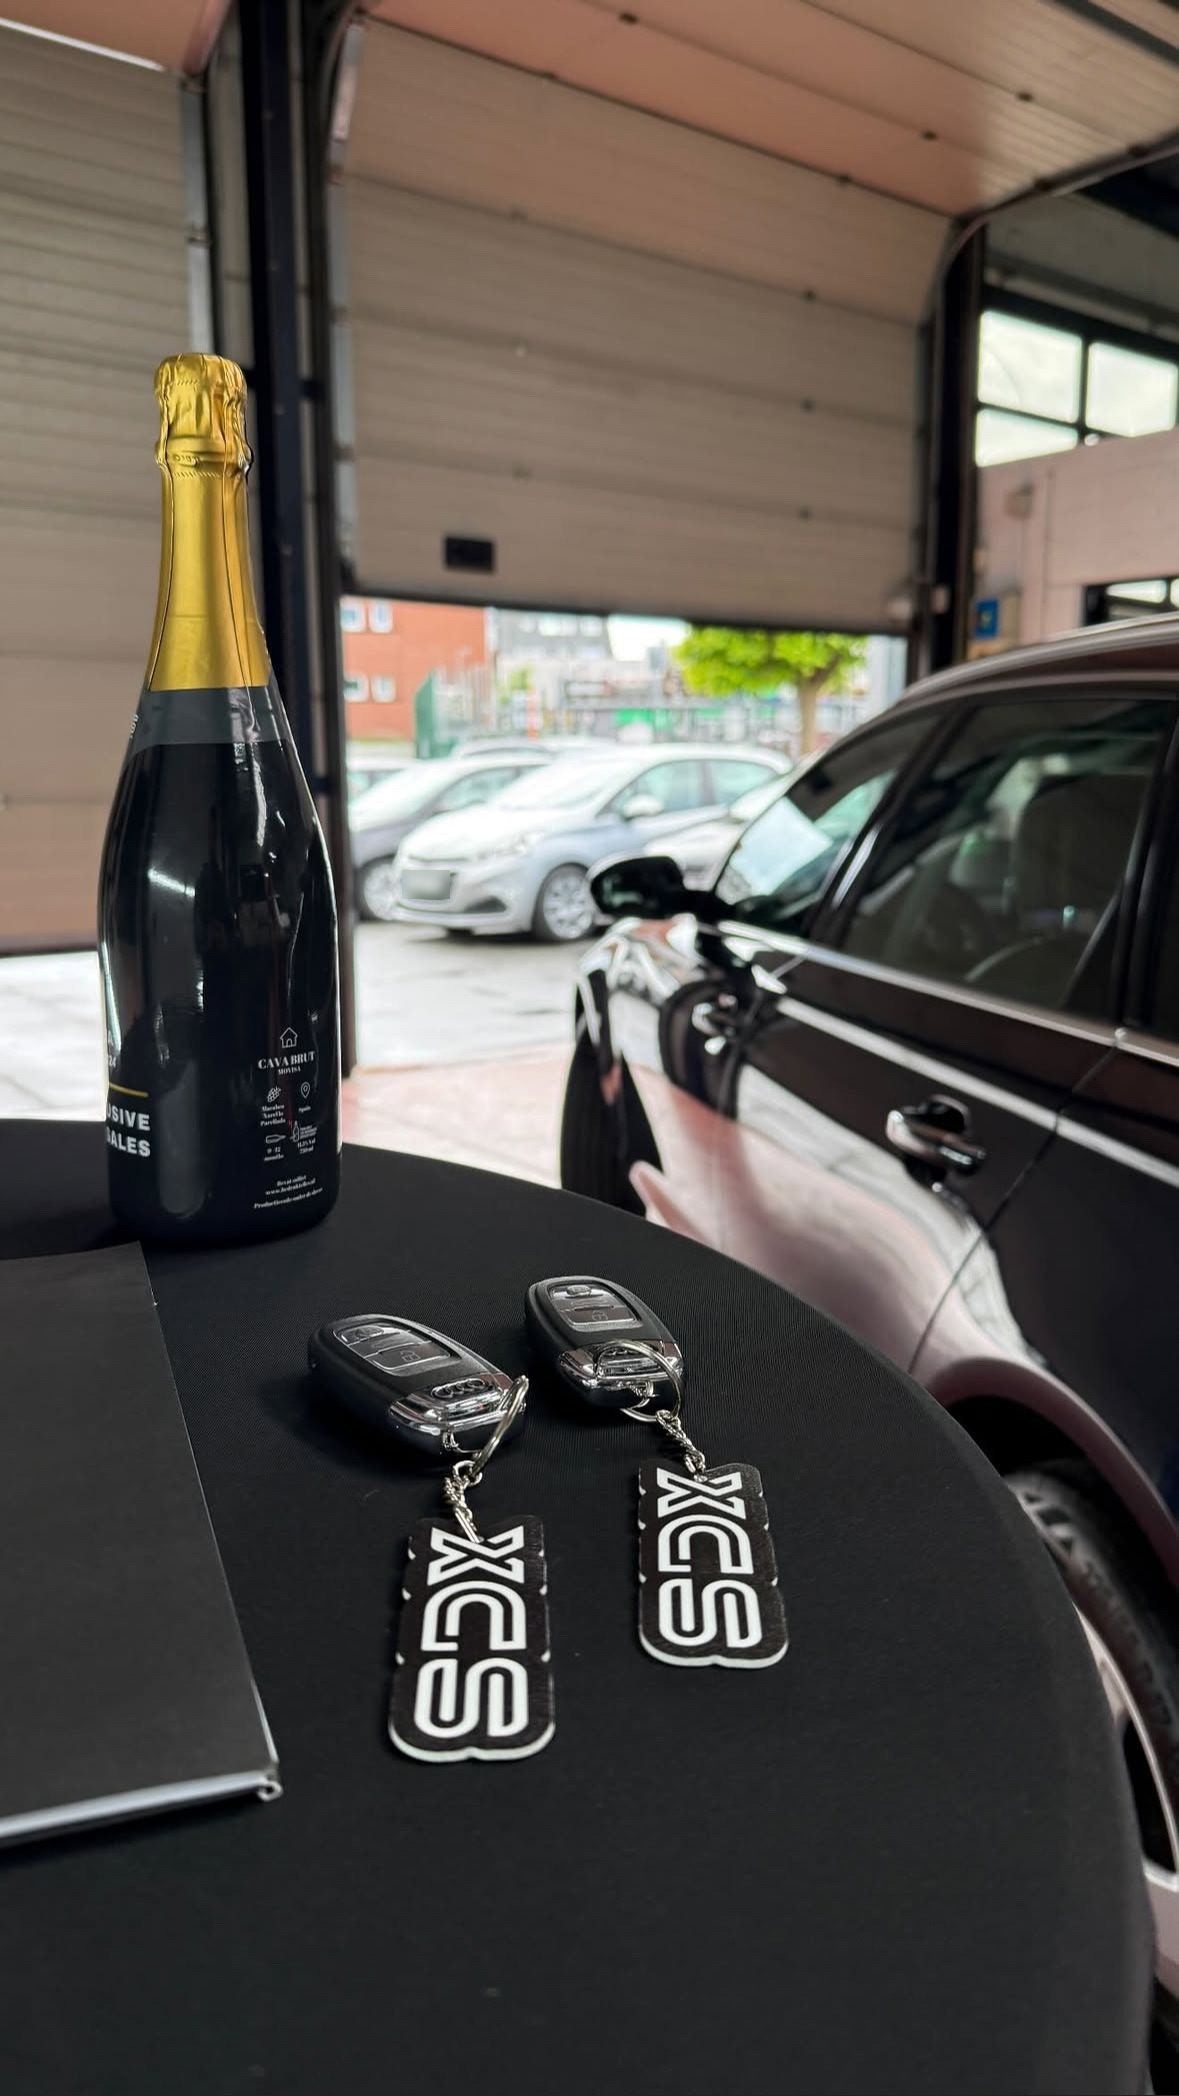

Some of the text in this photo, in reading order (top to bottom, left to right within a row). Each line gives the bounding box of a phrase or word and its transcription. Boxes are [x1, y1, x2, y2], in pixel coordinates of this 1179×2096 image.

[257, 1051, 315, 1069] CAVA BRUT
[413, 1525, 529, 1738] XCS
[656, 1467, 764, 1648] XCS
